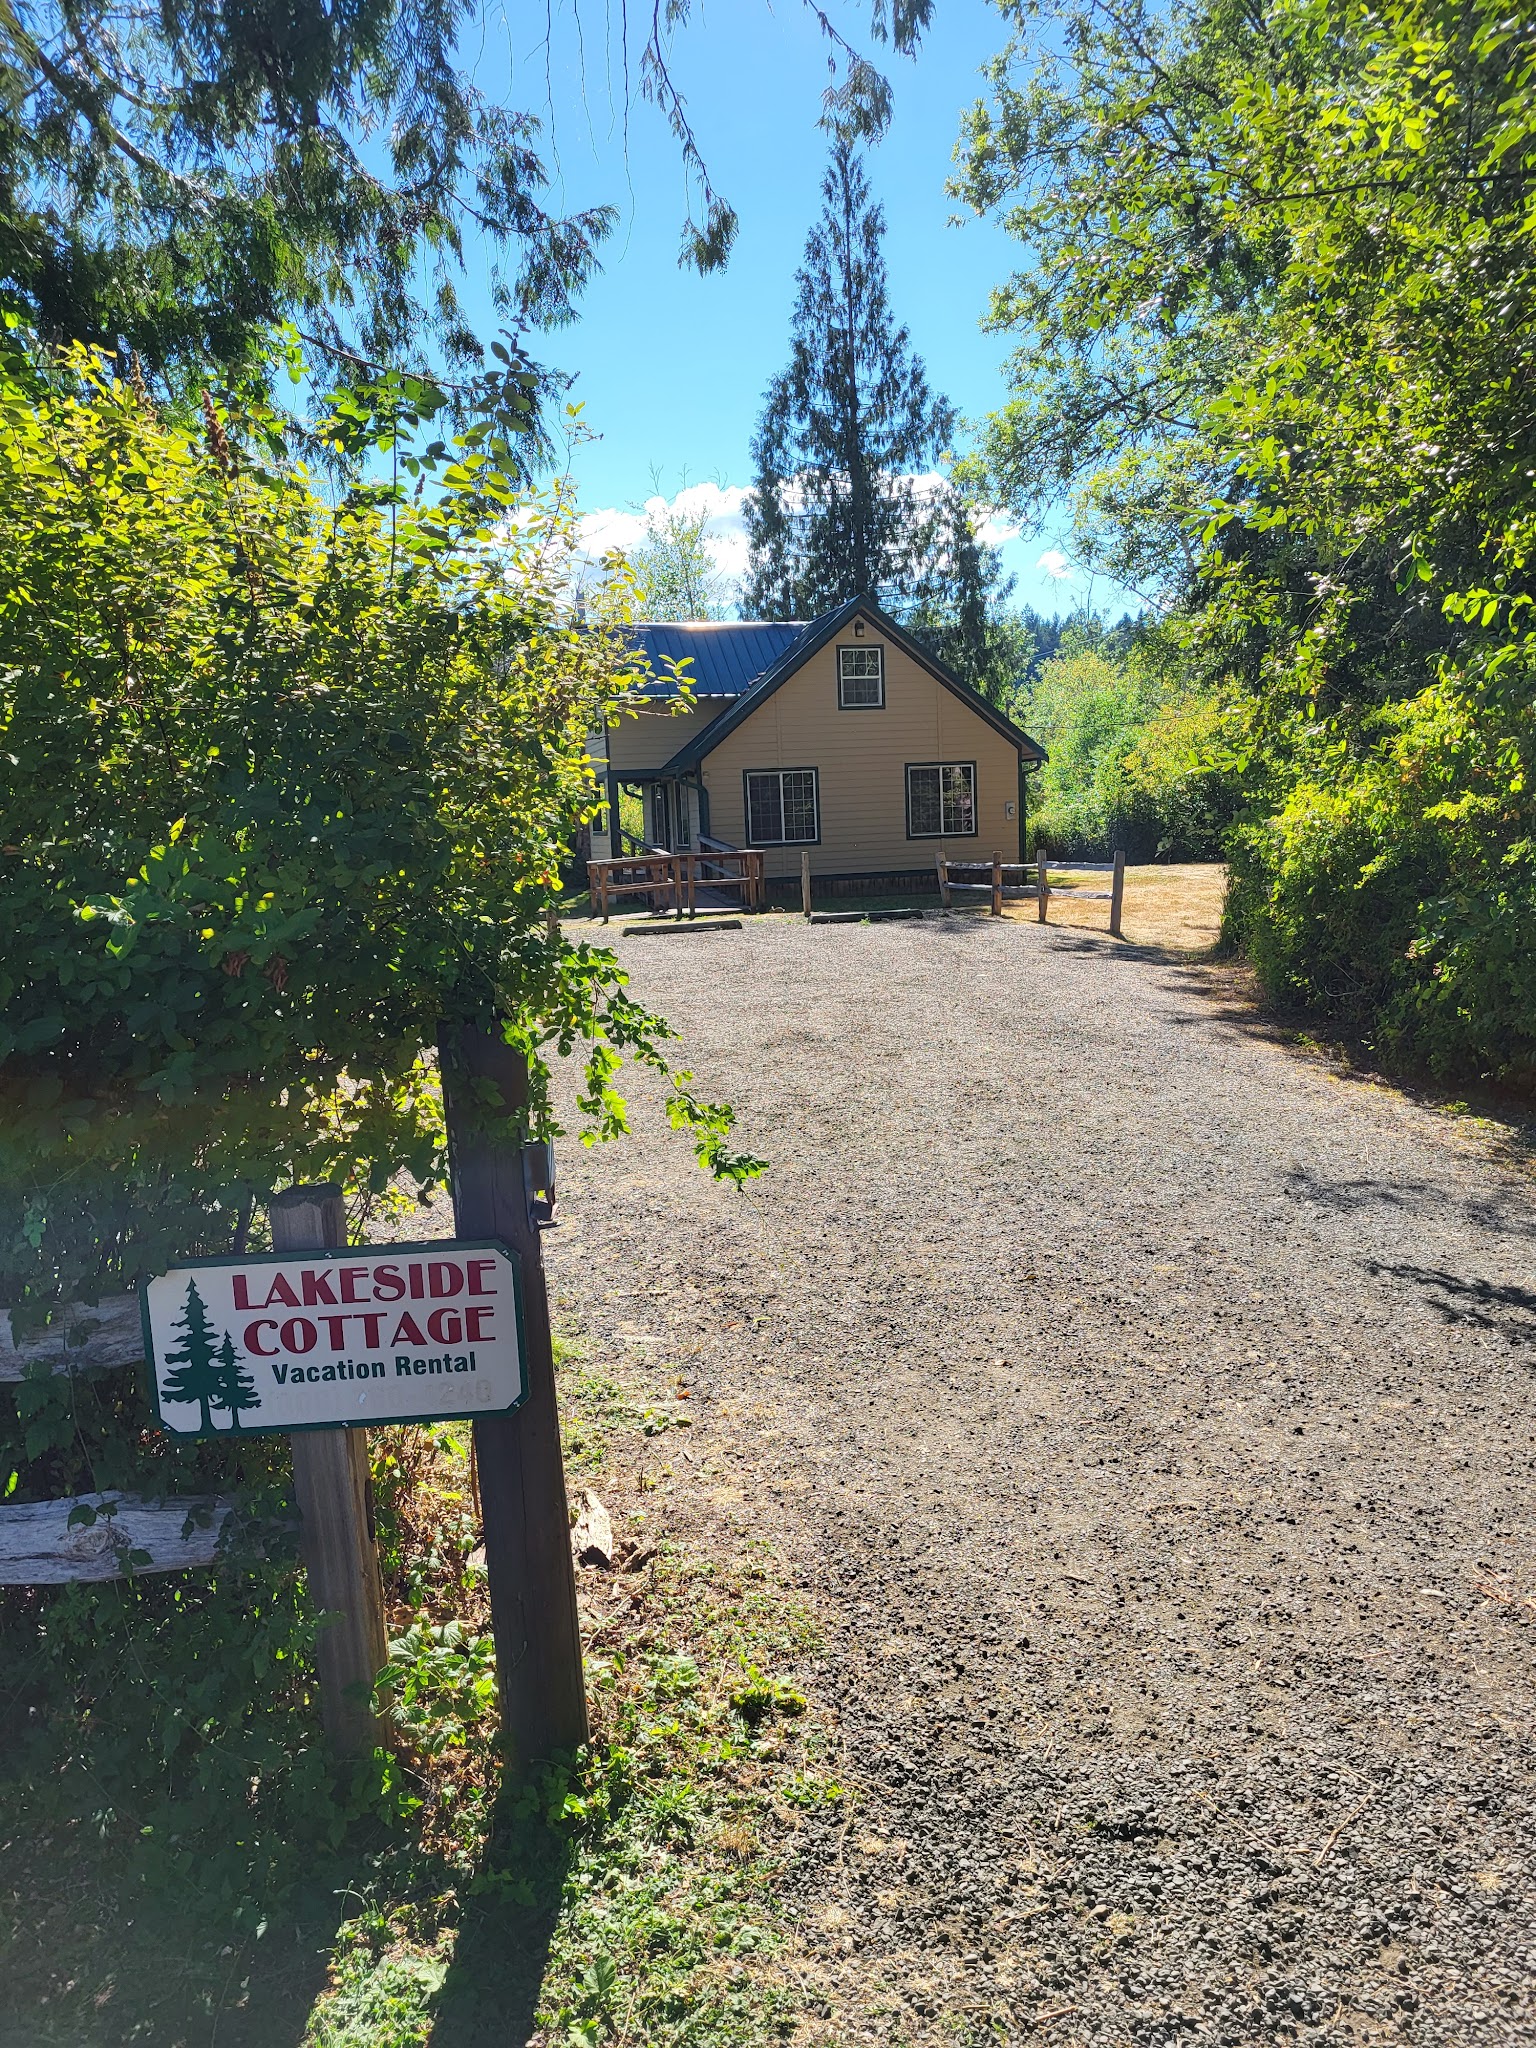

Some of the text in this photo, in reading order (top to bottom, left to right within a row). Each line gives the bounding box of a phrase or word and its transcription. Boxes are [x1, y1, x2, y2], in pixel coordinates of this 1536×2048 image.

[232, 1259, 498, 1311] LAKESIDE
[243, 1306, 497, 1356] COTTAGE
[271, 1351, 477, 1385] Vacation Rental
